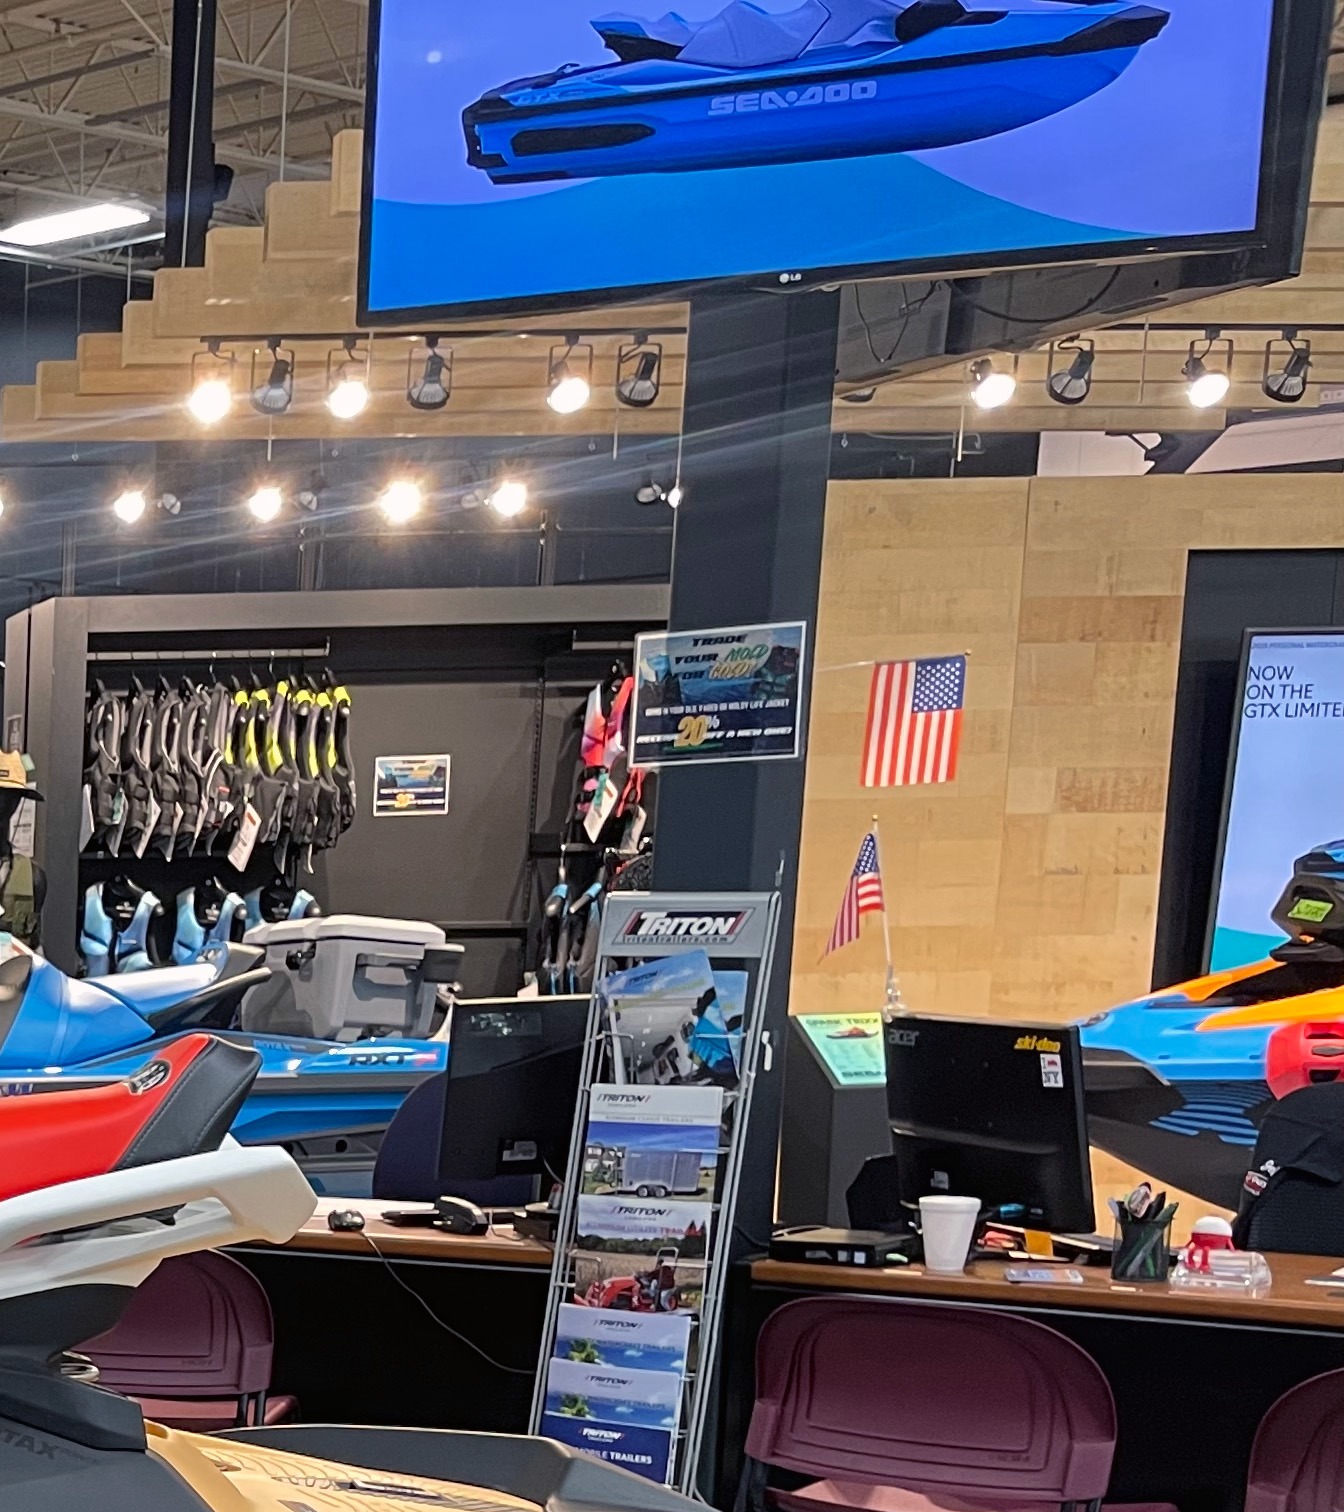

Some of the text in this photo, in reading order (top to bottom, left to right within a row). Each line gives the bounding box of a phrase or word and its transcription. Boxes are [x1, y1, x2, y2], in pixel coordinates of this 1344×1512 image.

[692, 633, 748, 647] TRADE
[674, 653, 719, 665] YOUR
[1248, 665, 1294, 681] NOW
[1247, 683, 1314, 700] ON THE
[1244, 702, 1344, 718] GTX LIMITE
[637, 911, 736, 936] TRITON
[888, 1028, 919, 1046] acer
[602, 1094, 645, 1103] TRITON
[617, 1206, 667, 1216] TRITON
[609, 1451, 653, 1465] TRAILERS
